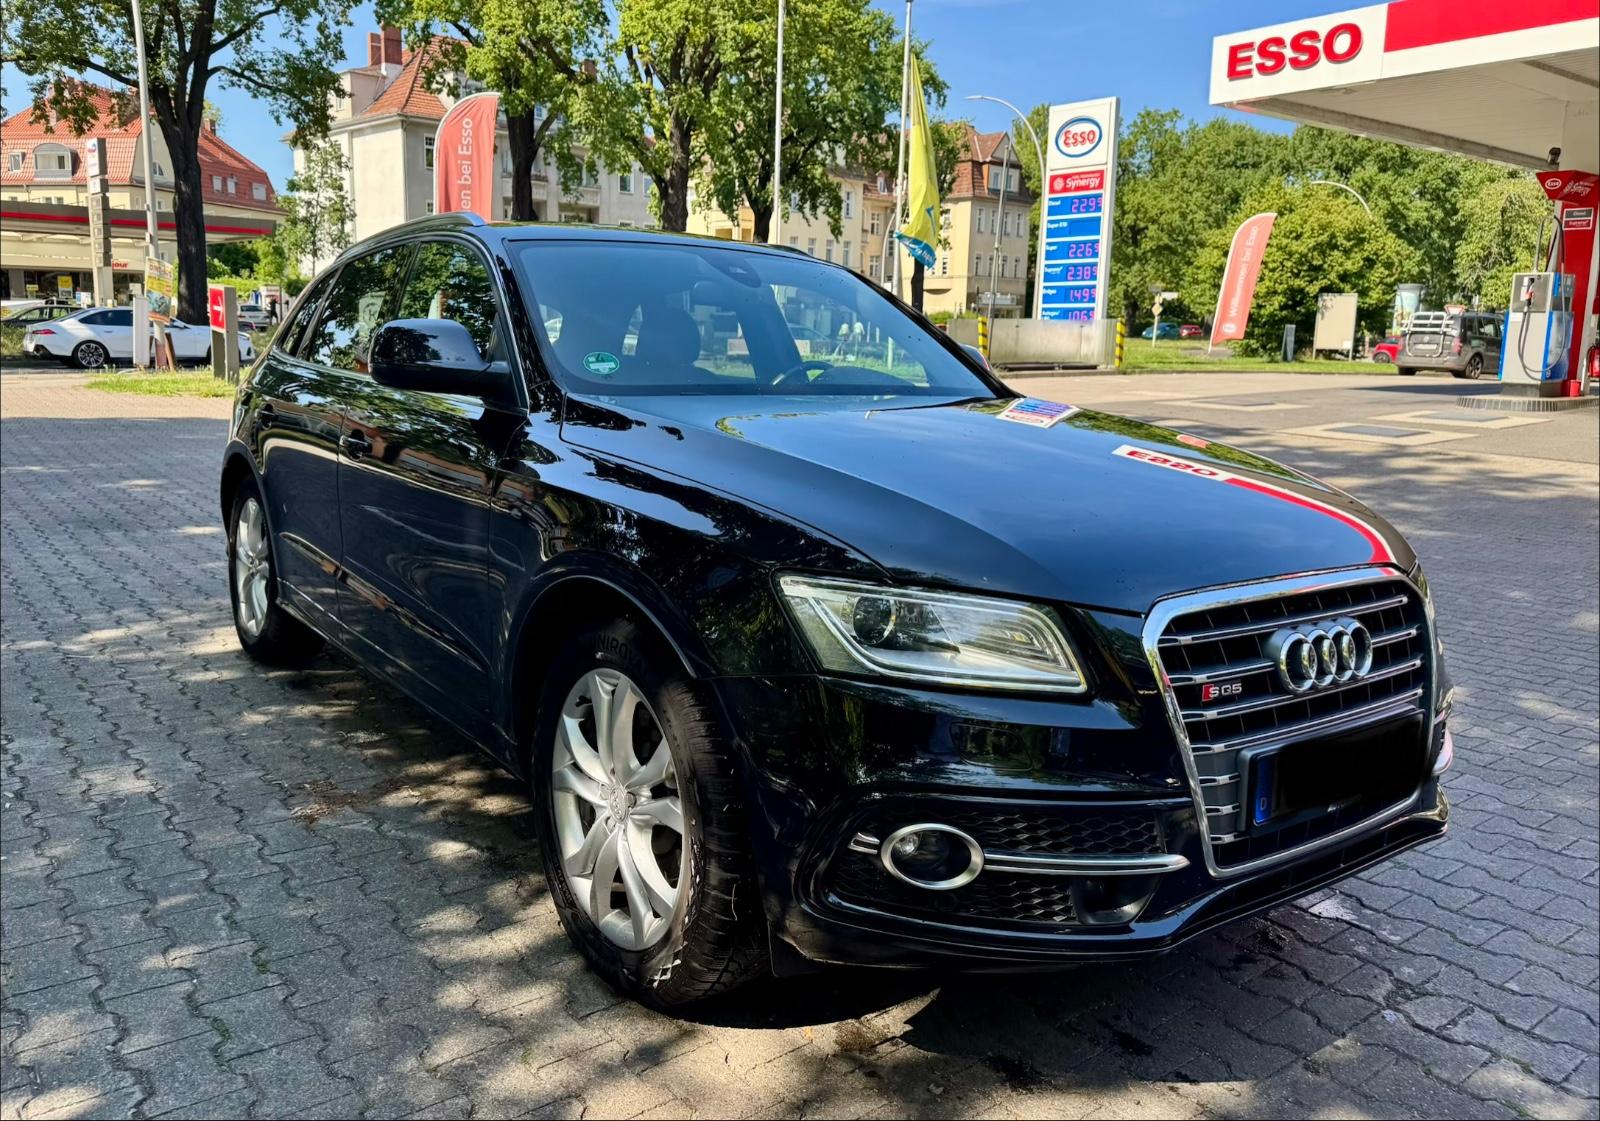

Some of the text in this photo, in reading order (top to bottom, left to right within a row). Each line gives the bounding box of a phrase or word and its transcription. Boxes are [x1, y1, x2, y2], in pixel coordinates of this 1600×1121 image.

[1227, 23, 1363, 80] ESSO
[458, 118, 473, 155] Esso
[458, 160, 472, 184] bei
[1065, 177, 1101, 190] Synergy
[1208, 683, 1242, 698] SQ5
